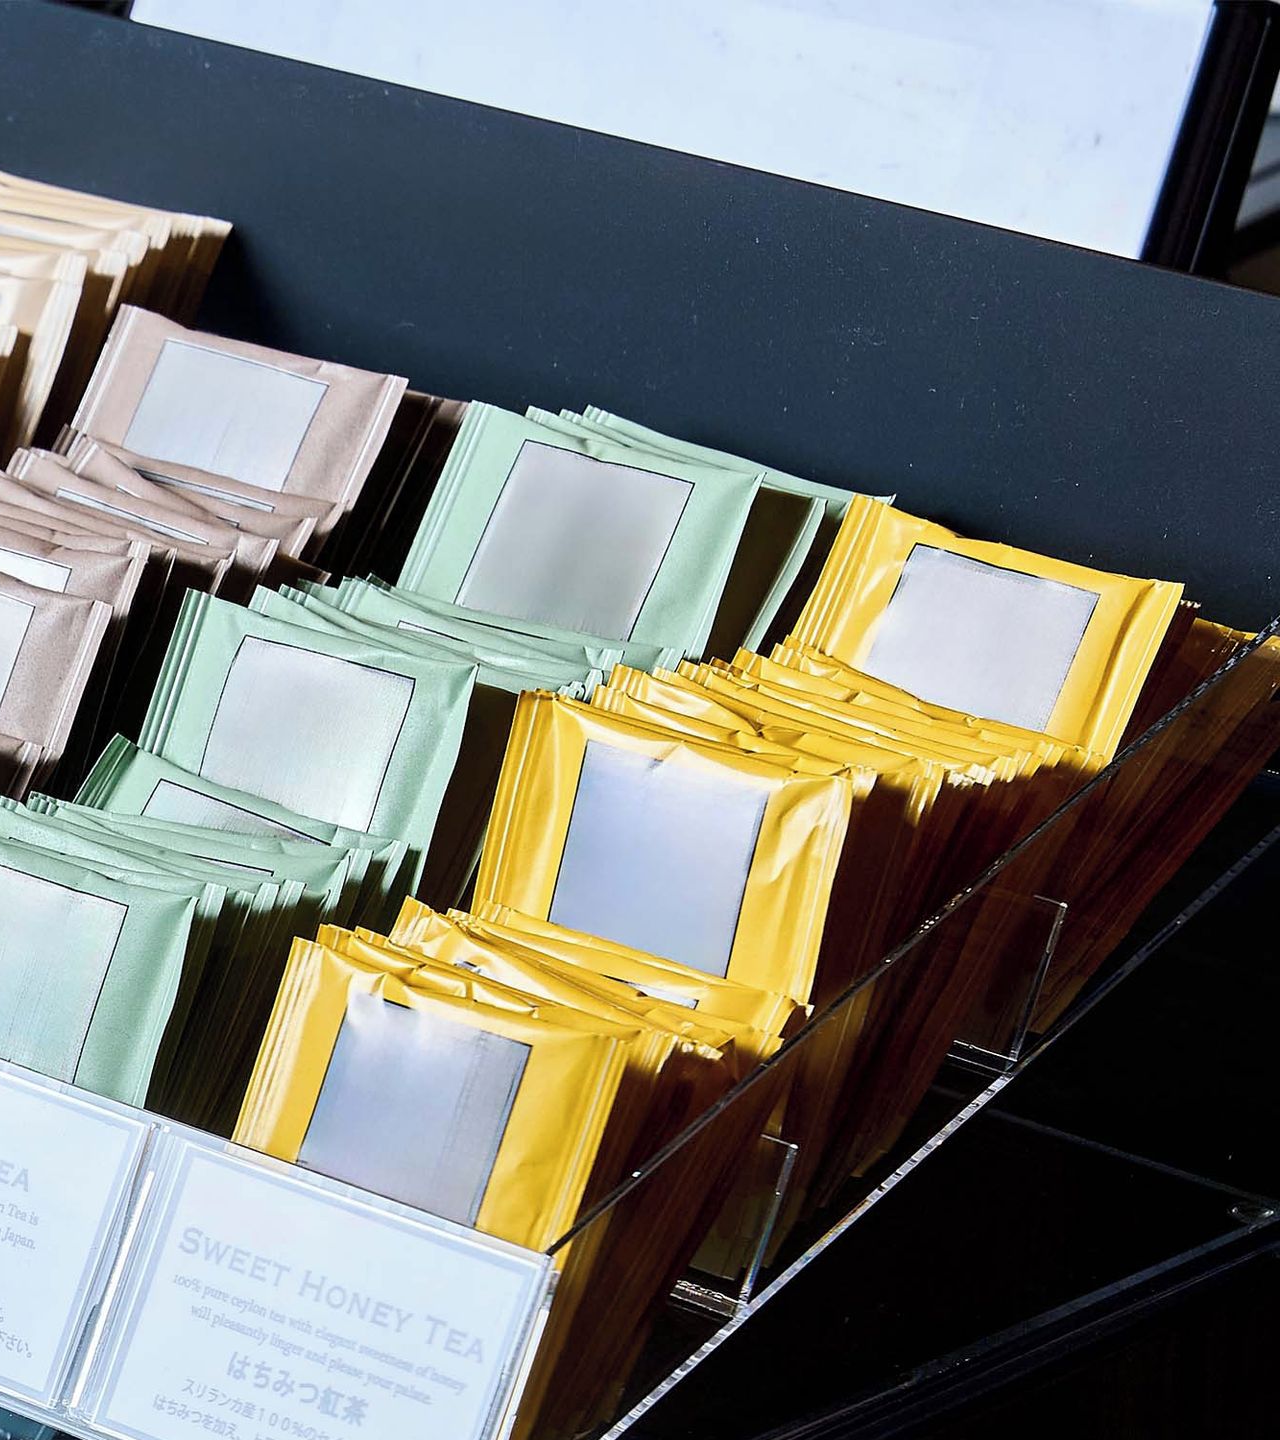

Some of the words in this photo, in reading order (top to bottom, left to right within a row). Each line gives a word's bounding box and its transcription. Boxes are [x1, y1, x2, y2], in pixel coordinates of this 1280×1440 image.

[0, 1226, 36, 1250] Japan.
[7, 1202, 28, 1222] Tea
[27, 1211, 39, 1226] is
[177, 1227, 291, 1287] SWEET
[297, 1270, 414, 1333] HONEY
[425, 1314, 483, 1364] TEA
[226, 1351, 369, 1427] はちみつ紅茶
